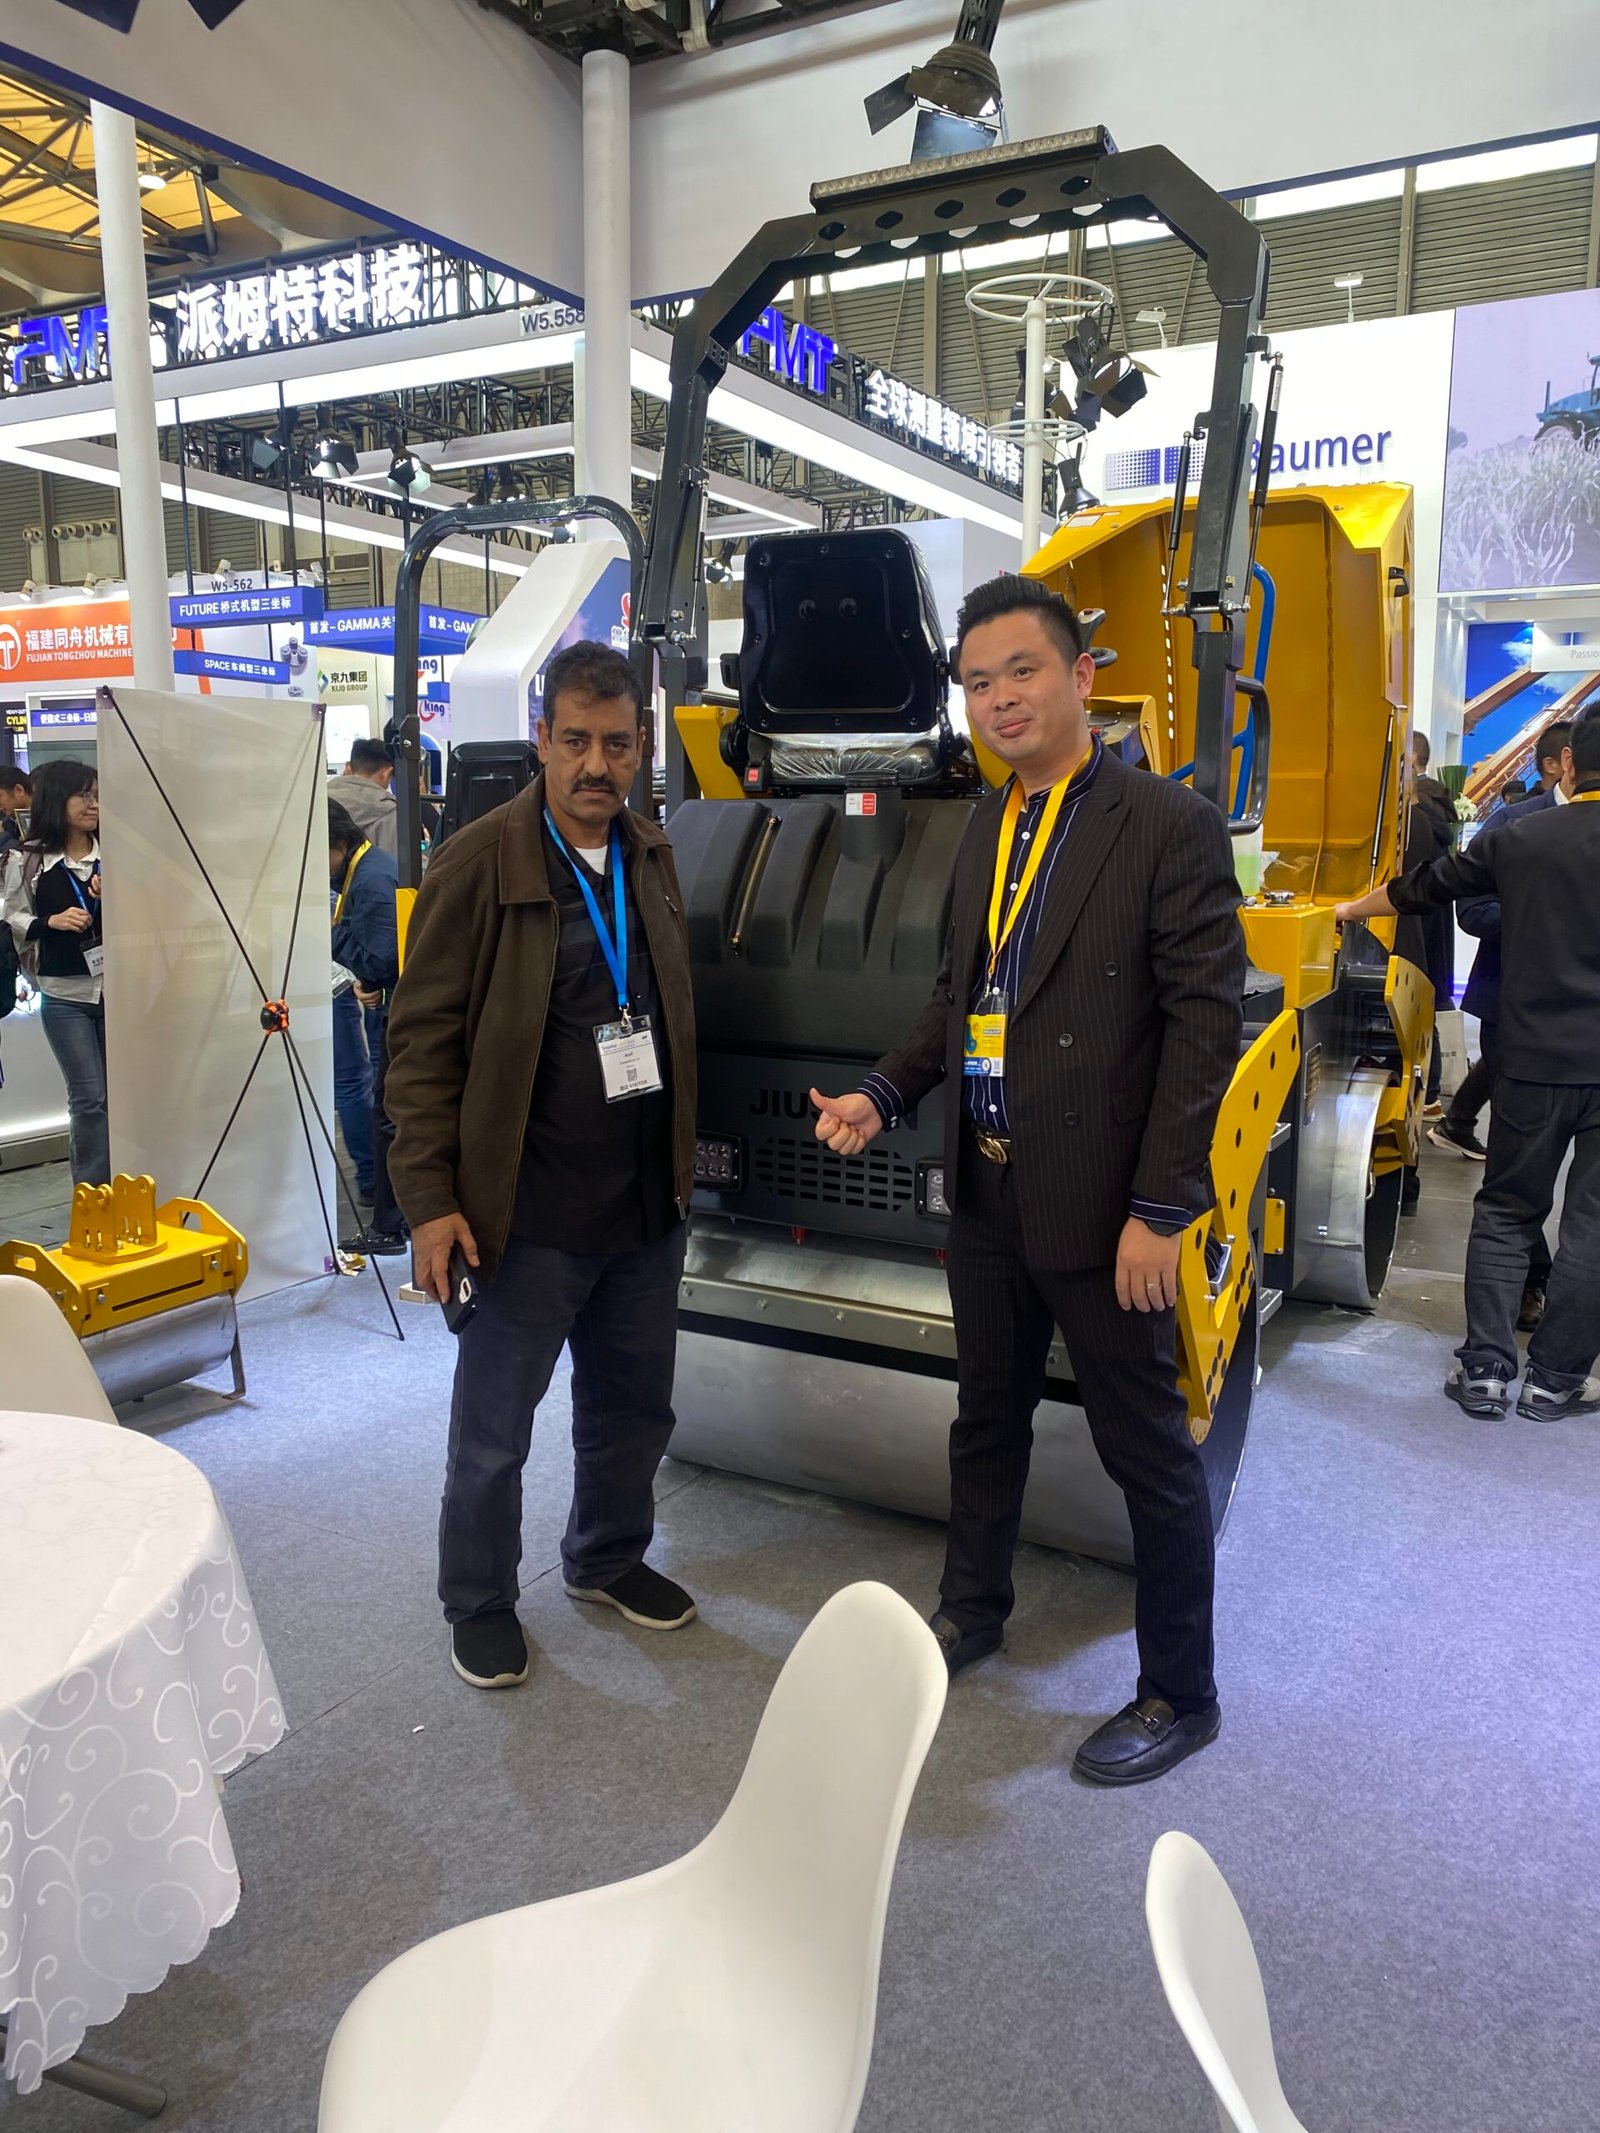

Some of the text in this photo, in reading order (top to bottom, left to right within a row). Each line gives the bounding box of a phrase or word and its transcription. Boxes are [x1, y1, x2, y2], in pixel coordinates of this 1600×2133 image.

[176, 243, 426, 352] 派姆特科技
[211, 578, 253, 592] W5-562
[180, 596, 292, 617] FUTURE 桥式机型三坐标
[381, 615, 396, 629] 关
[25, 624, 133, 651] 福建同舟机械有
[26, 652, 53, 663] FUJIAN
[53, 649, 97, 661] TONGZHOU
[204, 659, 231, 671] SPACE
[330, 670, 368, 683] 京九集团
